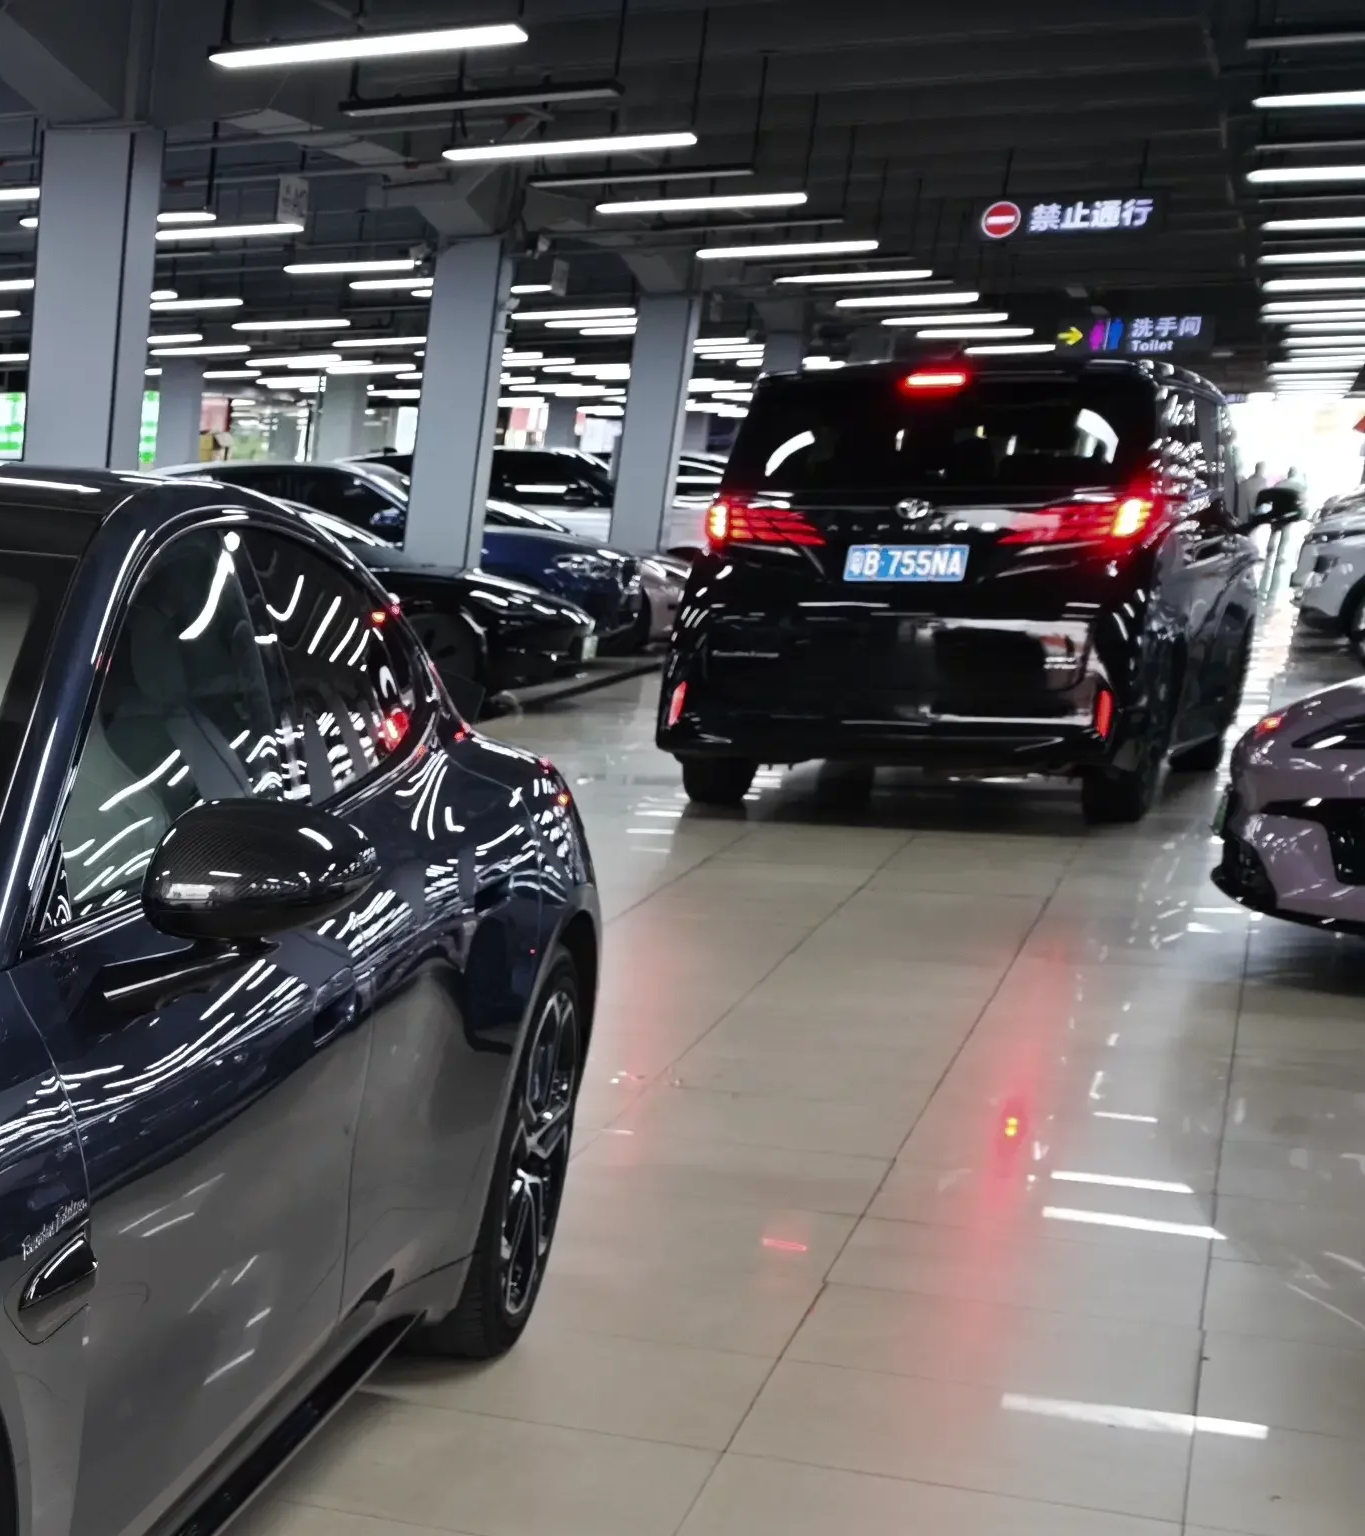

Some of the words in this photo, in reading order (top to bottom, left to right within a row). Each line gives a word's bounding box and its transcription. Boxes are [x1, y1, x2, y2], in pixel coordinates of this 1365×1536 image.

[1029, 199, 1153, 232] 禁止通行
[1131, 316, 1202, 337] 洗手间
[1131, 339, 1174, 352] Toilet
